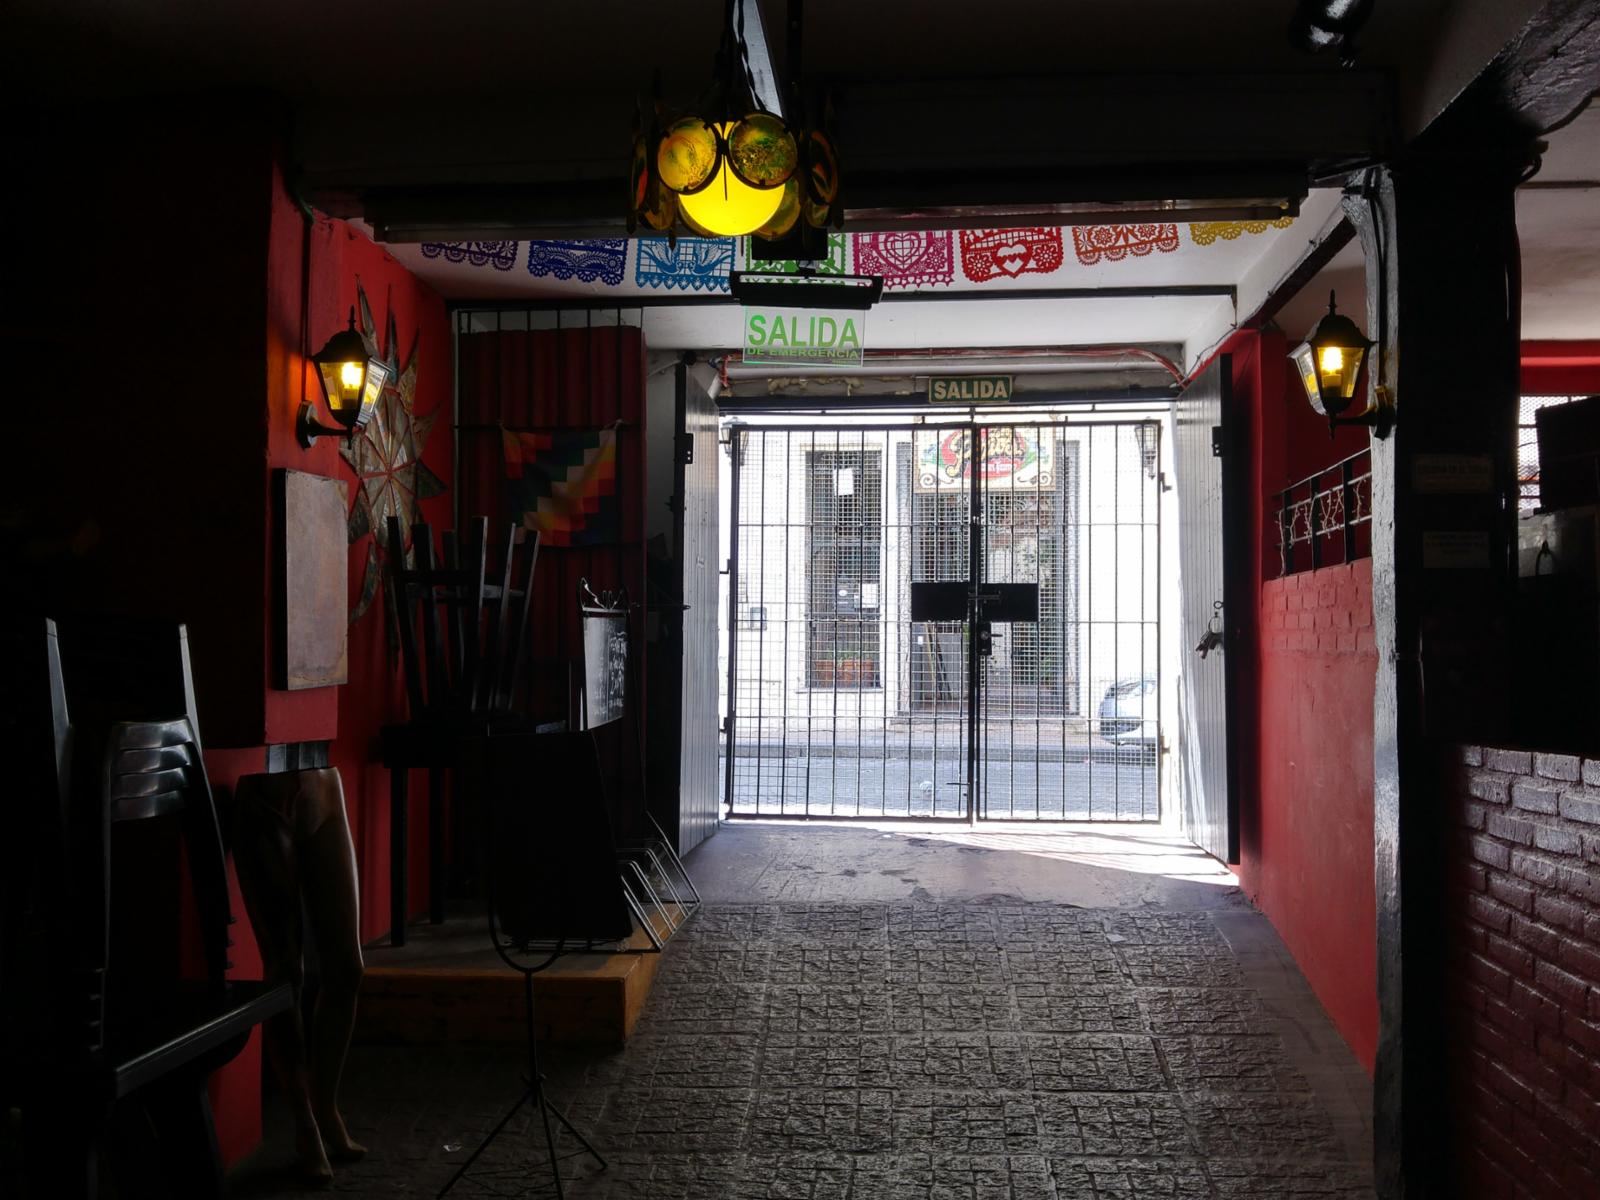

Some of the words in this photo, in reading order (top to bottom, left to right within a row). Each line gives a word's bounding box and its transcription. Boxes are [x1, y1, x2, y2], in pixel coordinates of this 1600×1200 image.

[748, 314, 859, 348] SALIDA
[747, 348, 765, 356] DE
[769, 349, 859, 359] EMERGENCIA
[934, 380, 1008, 399] SALIDA
